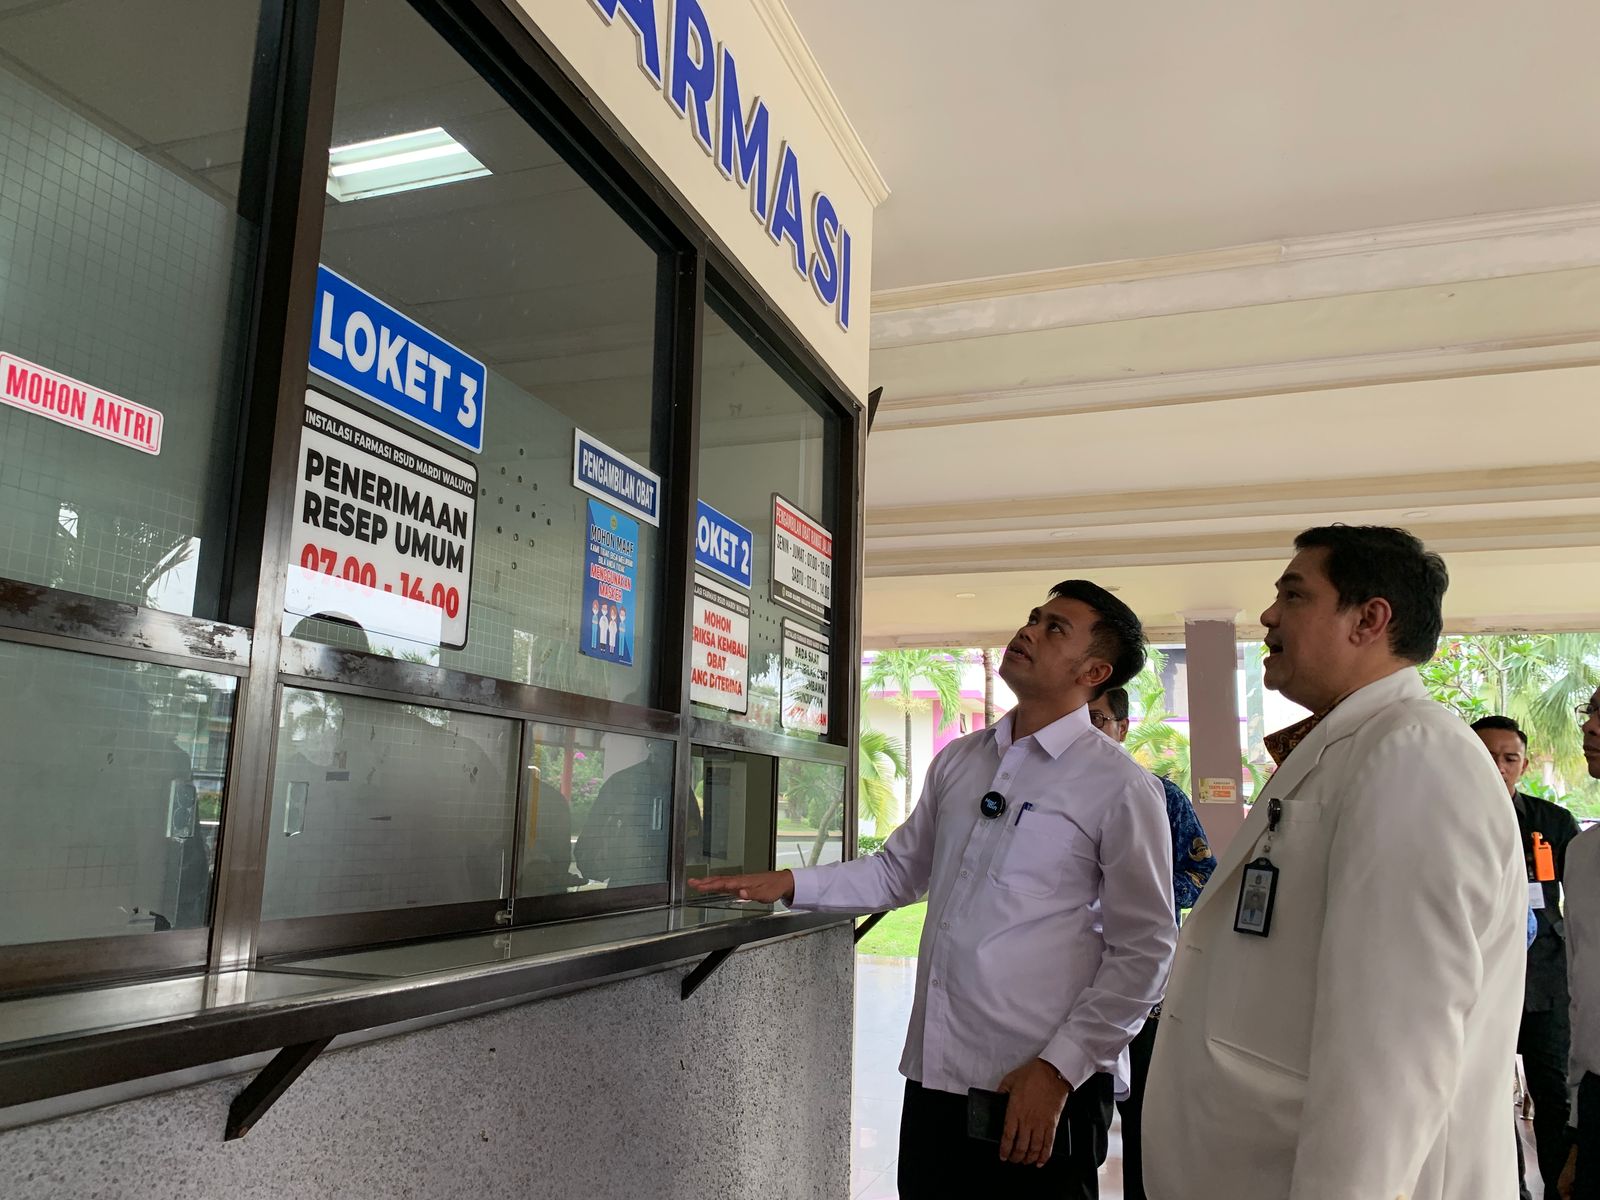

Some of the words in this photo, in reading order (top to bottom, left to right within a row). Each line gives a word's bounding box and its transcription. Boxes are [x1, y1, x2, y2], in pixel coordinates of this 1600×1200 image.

[318, 290, 452, 413] LOKET
[456, 370, 479, 430] 3
[6, 363, 87, 421] MOHON
[92, 397, 153, 444] ANTRI
[305, 409, 353, 442] INSTALASI
[354, 432, 392, 460] FARMASI
[393, 450, 415, 469] RSUD
[416, 459, 441, 480] MARDI
[442, 470, 473, 495] WALUYO
[582, 448, 636, 500] PENGAMBILAN
[636, 479, 654, 510] OBAT
[305, 448, 468, 540] PENERIMAAN
[302, 490, 388, 545] RESEP
[395, 521, 464, 573] UMUM
[590, 524, 615, 549] MOHON
[615, 536, 634, 557] MAAF
[695, 515, 739, 568] OKET
[740, 540, 750, 576] 2
[692, 625, 716, 649] RIKSA
[717, 634, 748, 660] KEMBALI
[704, 609, 732, 634] MOHON
[691, 667, 708, 688] ANG
[709, 672, 743, 697] DITERIMA
[706, 651, 726, 672] OBAT
